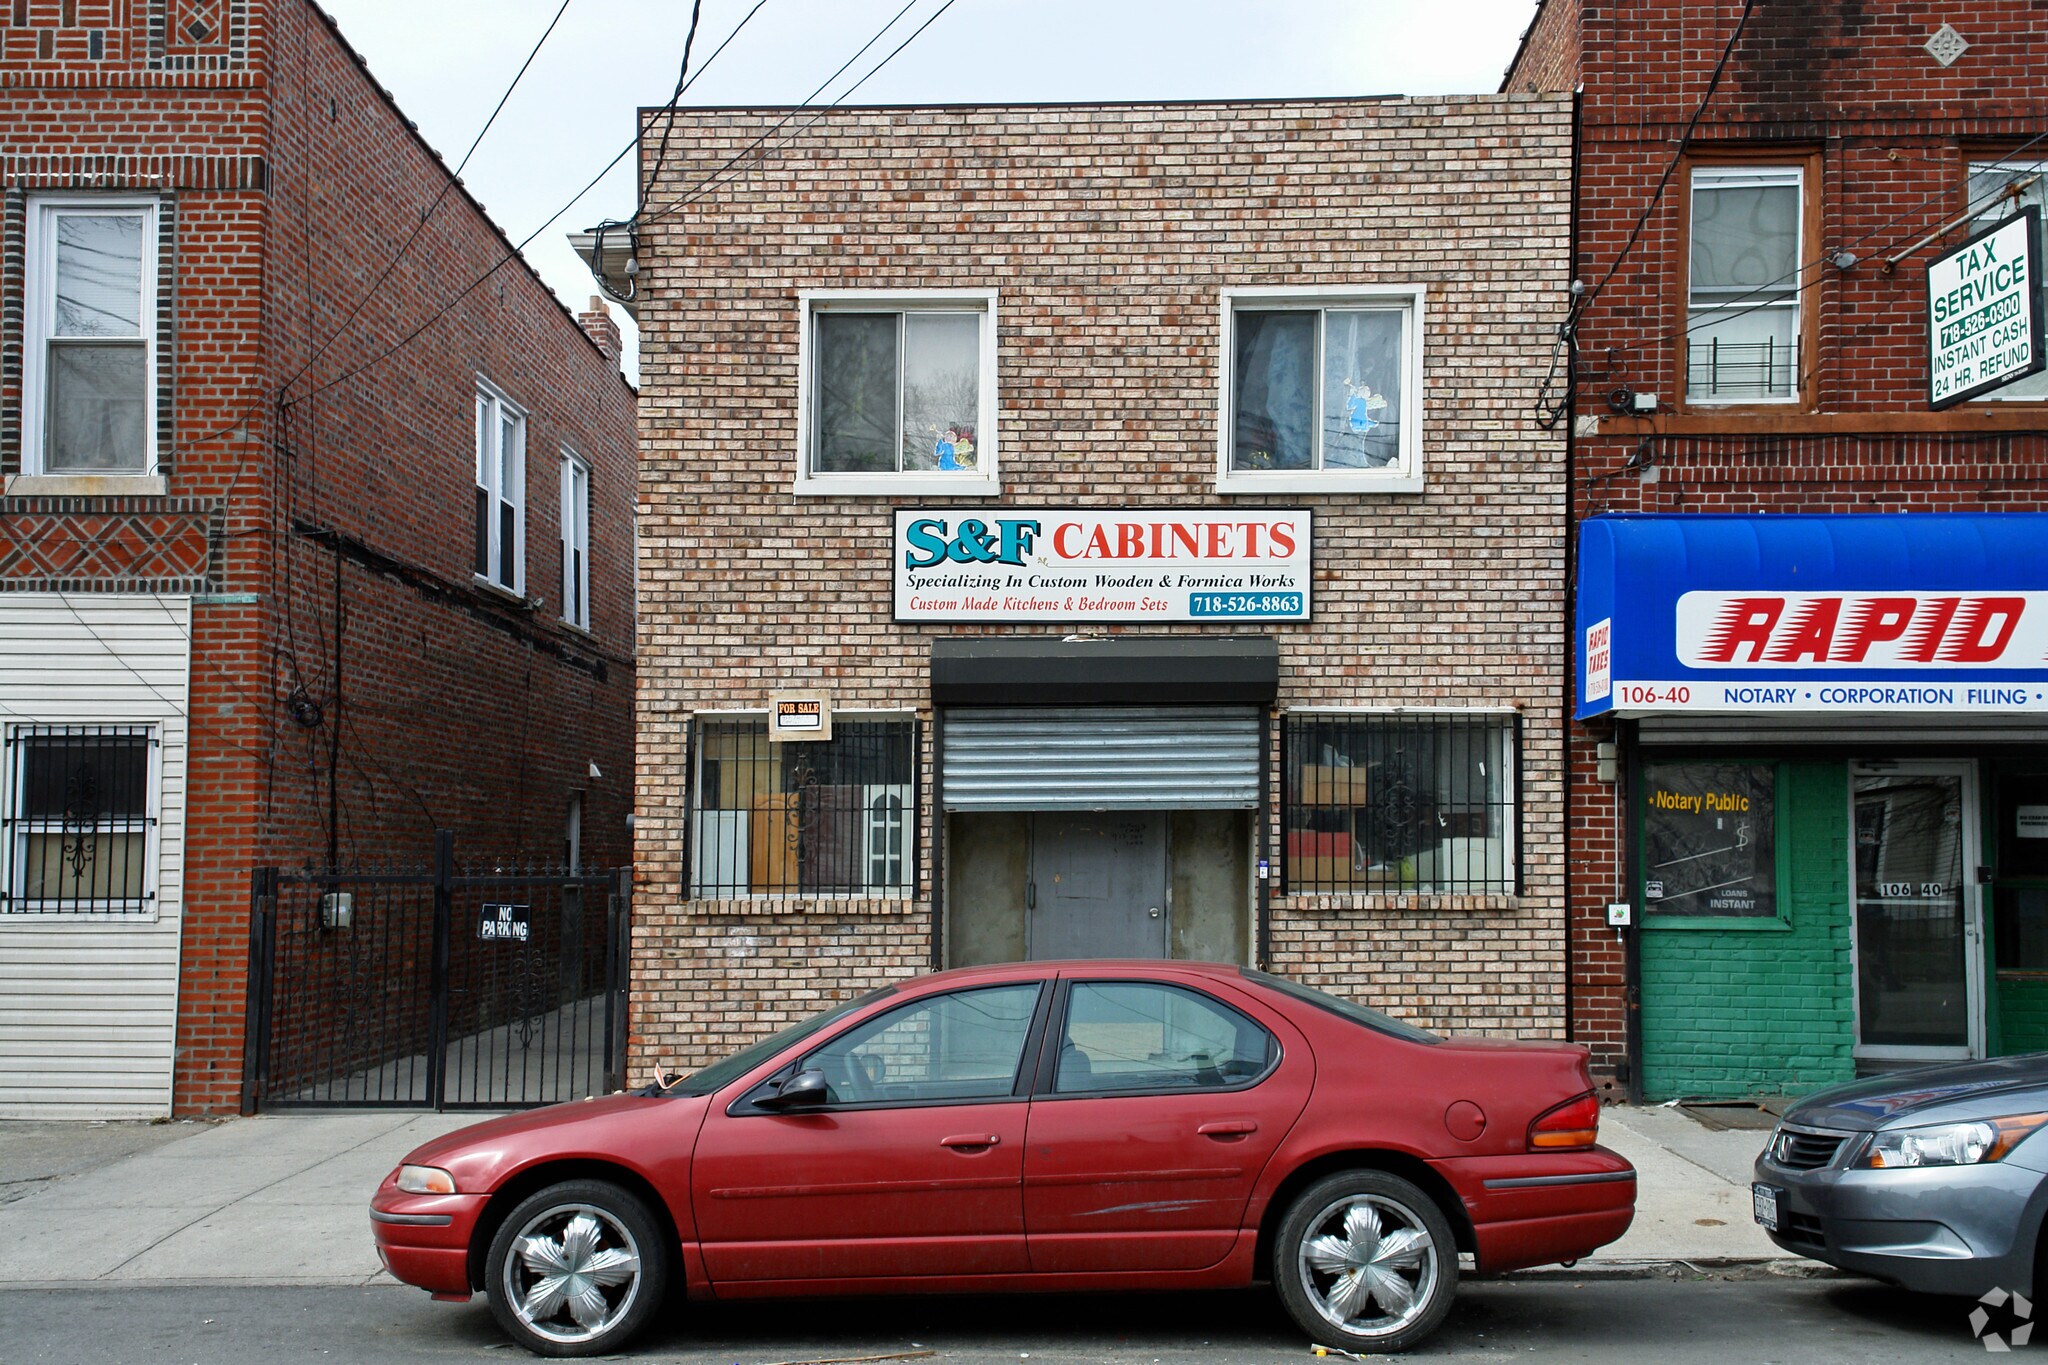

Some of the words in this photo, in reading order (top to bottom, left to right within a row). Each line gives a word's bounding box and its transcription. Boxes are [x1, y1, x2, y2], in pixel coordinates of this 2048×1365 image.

[1956, 238, 1997, 280] TAX
[1934, 255, 2025, 323] SERVICE
[1941, 294, 2020, 346] 718-526-0300
[1934, 335, 1986, 374] INSTANT
[1992, 316, 2028, 349] CASH
[1935, 377, 1949, 397] 24
[1954, 367, 1975, 389] HR.
[1980, 342, 2029, 380] REFUND
[906, 518, 1041, 571] S&F
[1053, 522, 1296, 559] CABINETS
[906, 574, 1001, 591] Specializing
[1005, 575, 1023, 588] In
[1028, 574, 1087, 588] Custom
[1095, 575, 1154, 588] Wooden
[1159, 576, 1172, 588] &
[1177, 574, 1243, 588] Formica
[1249, 574, 1295, 588] Works
[910, 596, 962, 611] Custom
[962, 597, 998, 611] Made
[1003, 596, 1059, 611] Kitchens
[1064, 597, 1074, 611] &
[1078, 597, 1135, 611] Bedroom
[1140, 597, 1168, 611] Sets
[1194, 596, 1299, 612] 718-526-8863
[1588, 626, 1609, 652] RAPID
[1696, 597, 2026, 662] RAPID
[1588, 650, 1609, 675] TAXES
[1621, 687, 1690, 703] 106-40
[1724, 688, 1796, 704] NOTARY
[1820, 688, 1953, 704] CORPORATION
[1968, 689, 2027, 704] FILING
[779, 703, 795, 713] FOR
[798, 703, 819, 713] SALE
[1656, 790, 1701, 814] Notary
[1706, 792, 1749, 811] Public
[1883, 884, 1910, 895] 106
[1922, 884, 1941, 895] 40
[499, 906, 512, 921] NO
[1710, 899, 1756, 909] INSTANT
[482, 921, 527, 936] PARKNG
